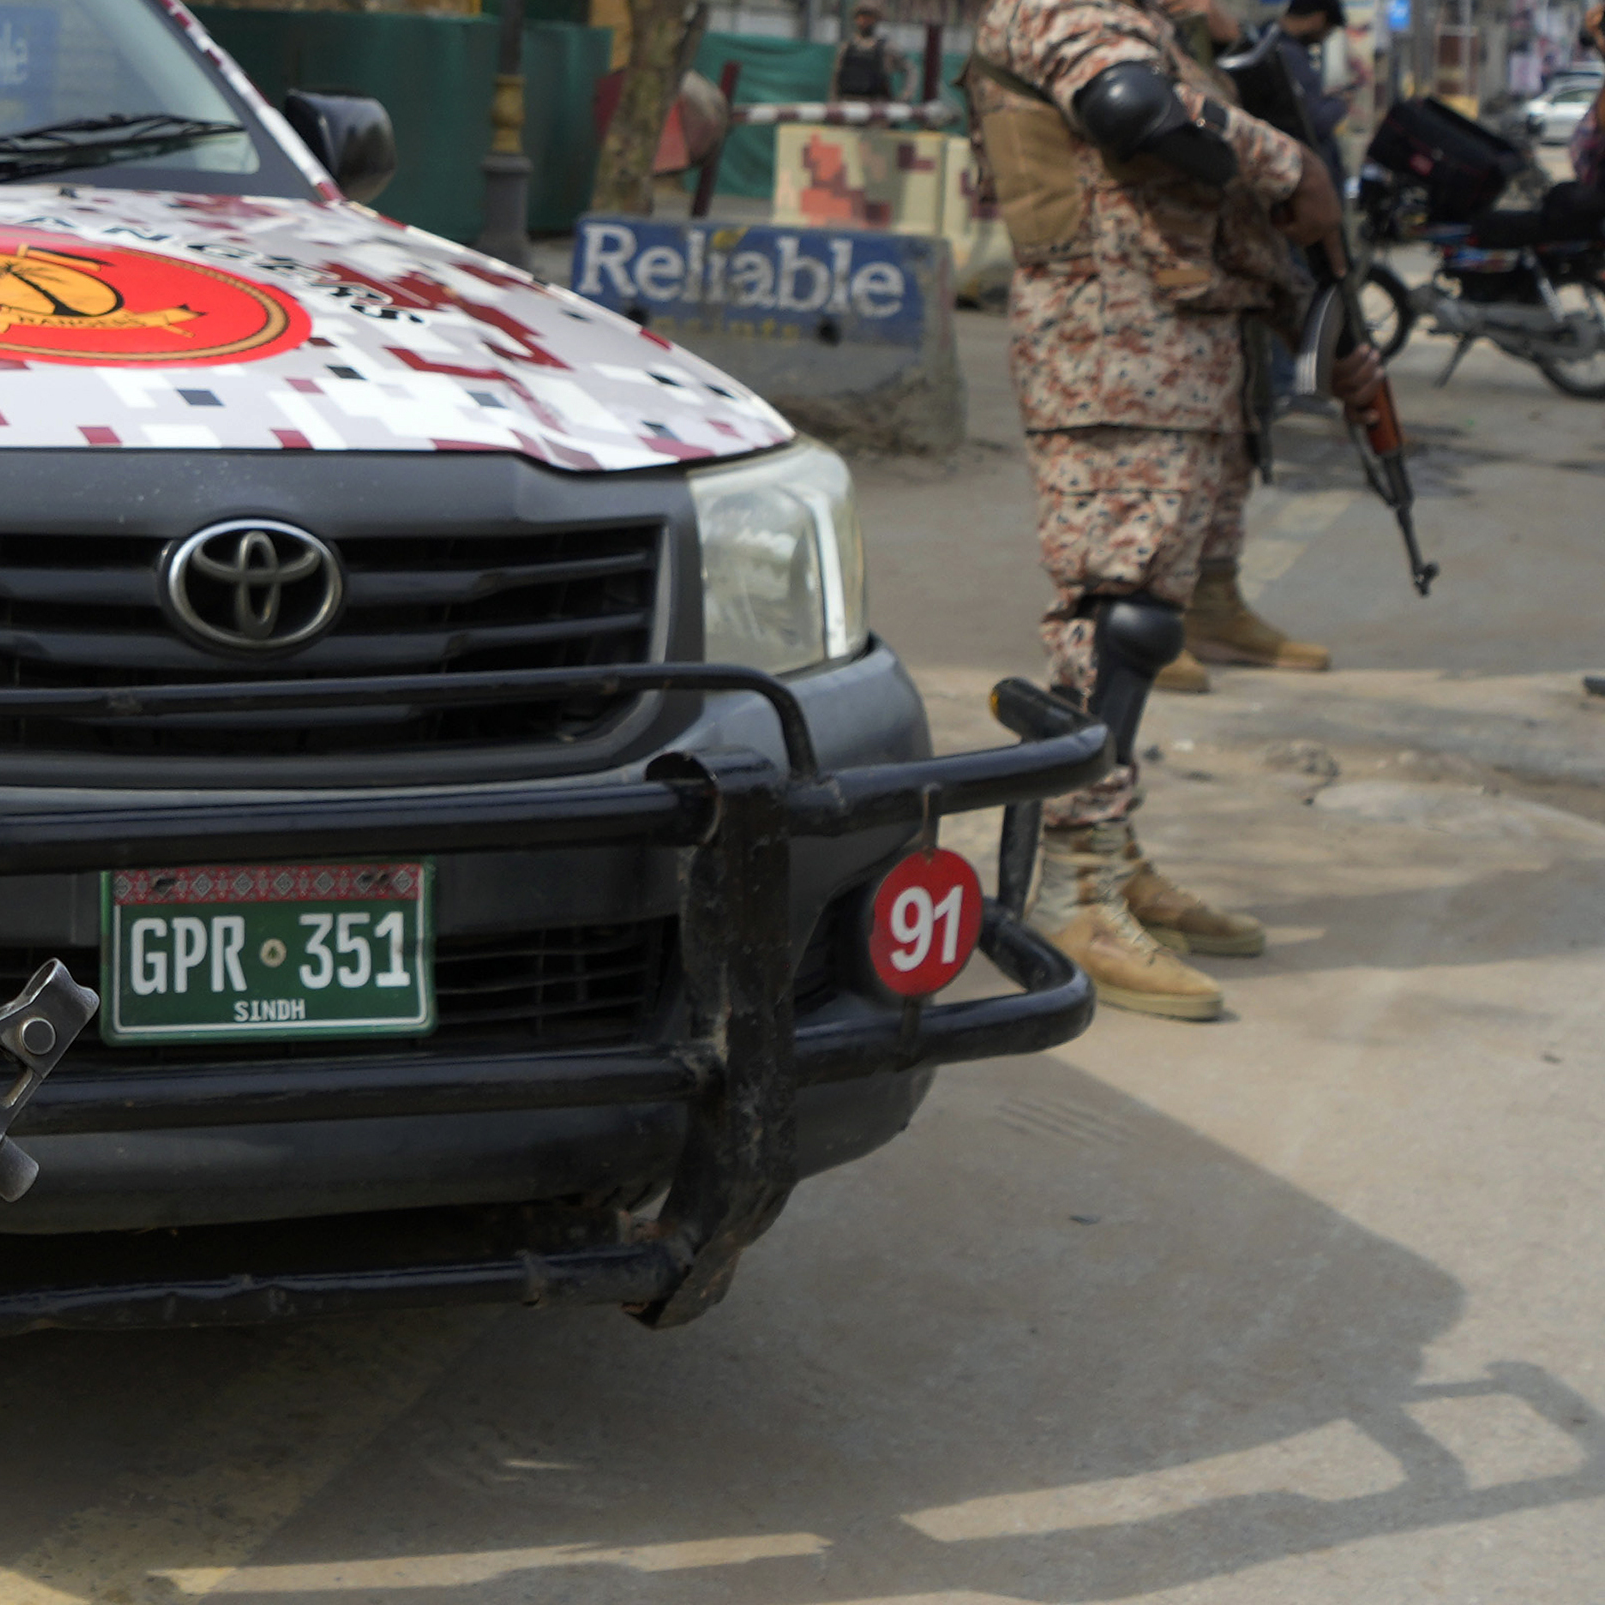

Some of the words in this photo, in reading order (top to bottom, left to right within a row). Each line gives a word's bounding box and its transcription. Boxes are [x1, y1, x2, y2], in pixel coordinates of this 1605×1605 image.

[577, 221, 905, 319] Reliable
[130, 915, 248, 996] GPR
[298, 911, 412, 990] 351
[890, 884, 965, 973] 91
[233, 998, 307, 1023] SINDH
